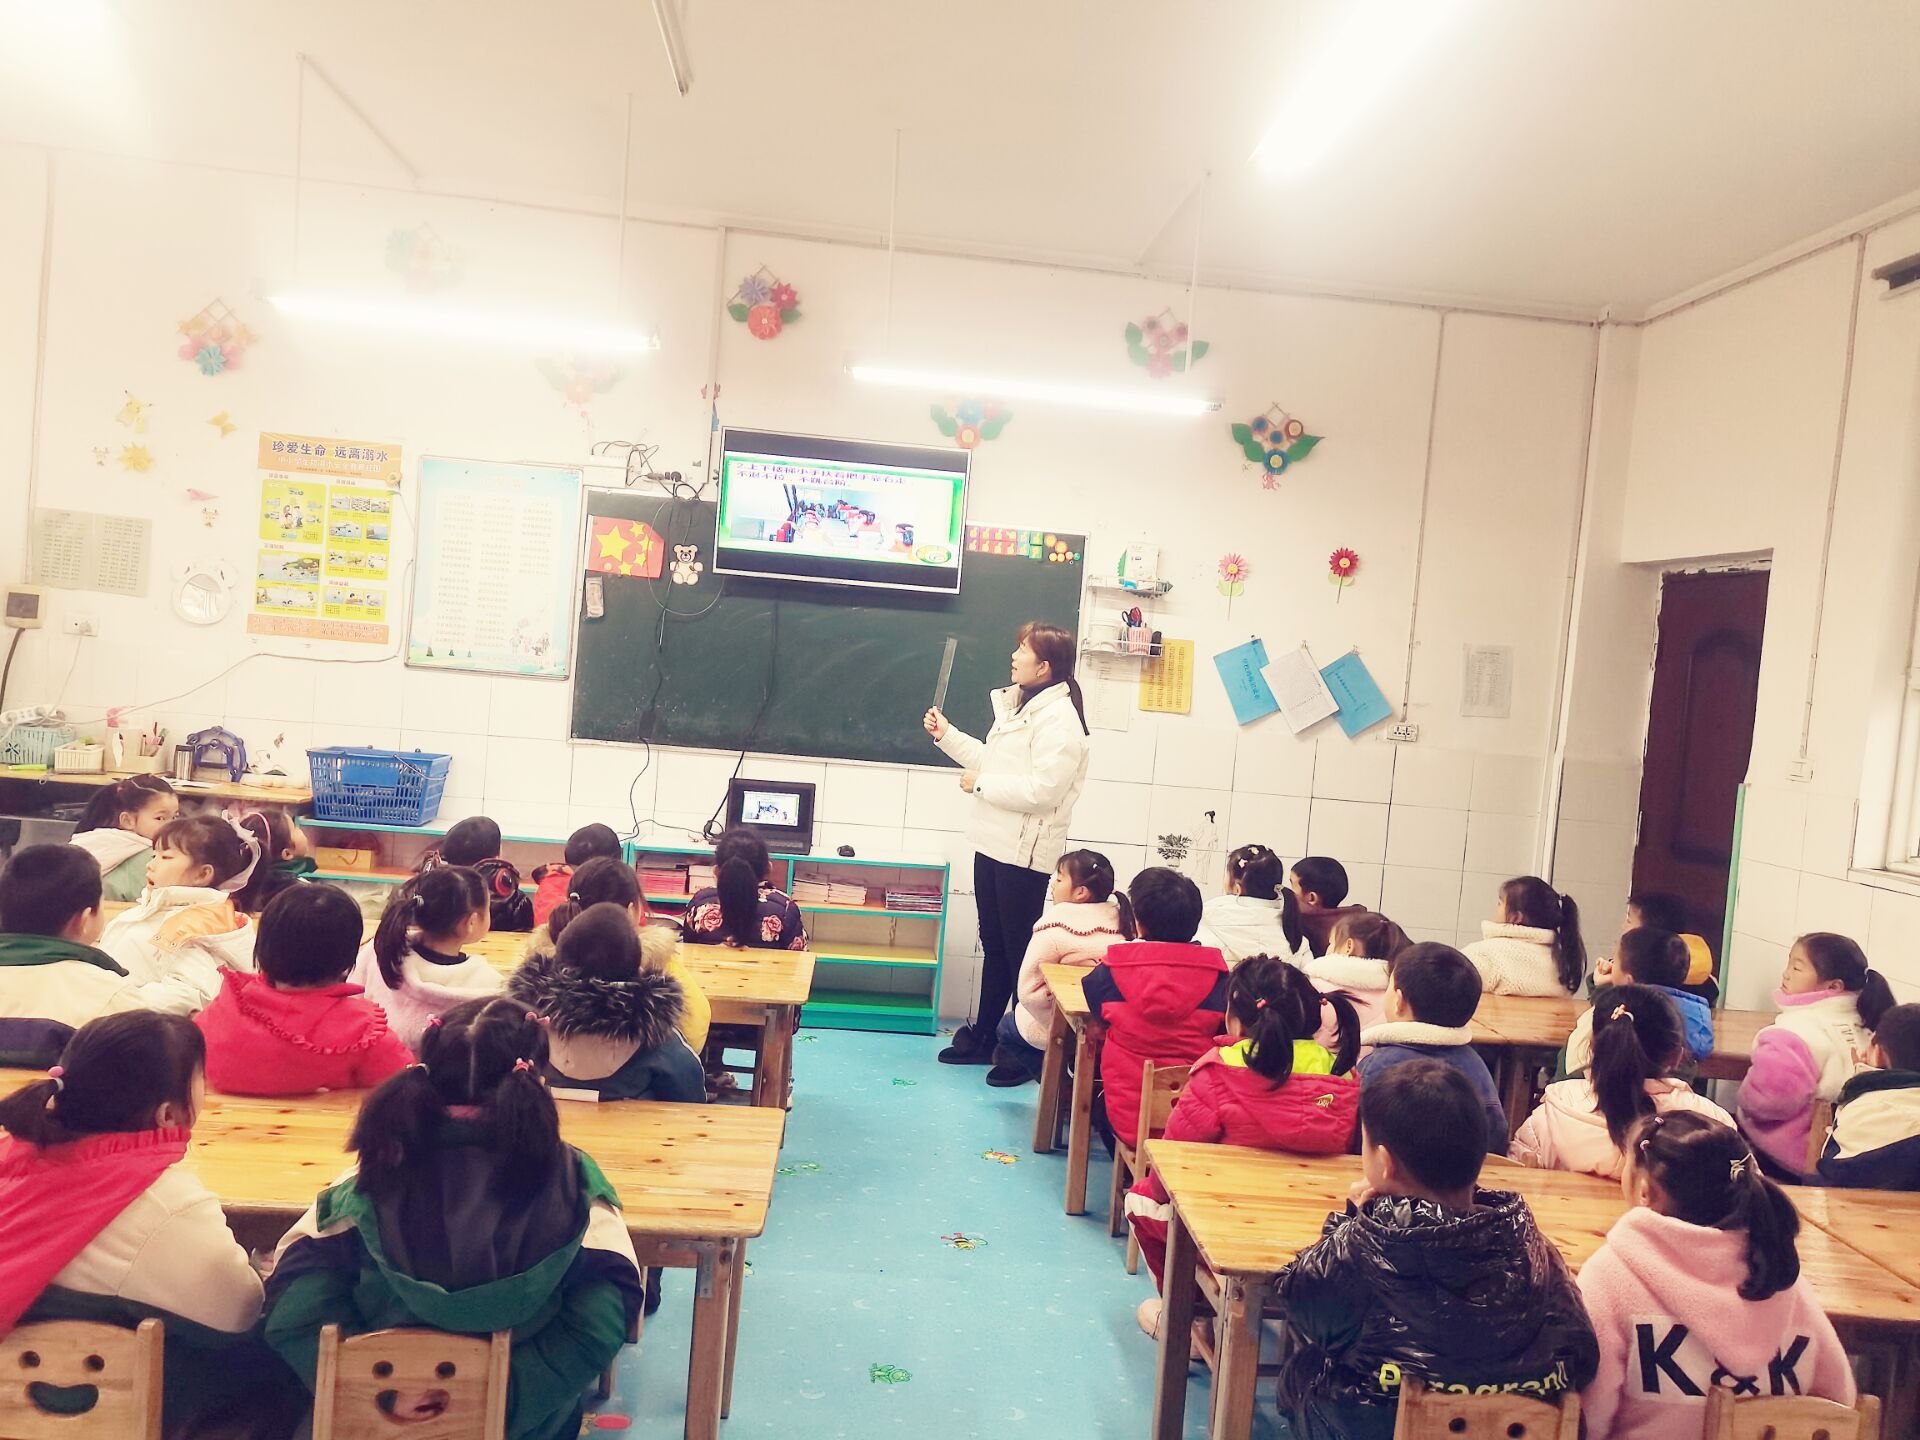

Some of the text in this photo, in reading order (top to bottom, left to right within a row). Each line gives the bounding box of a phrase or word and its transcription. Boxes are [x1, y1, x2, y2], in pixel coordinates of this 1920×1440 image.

[272, 440, 389, 463] 珍爱生命 远离溺水
